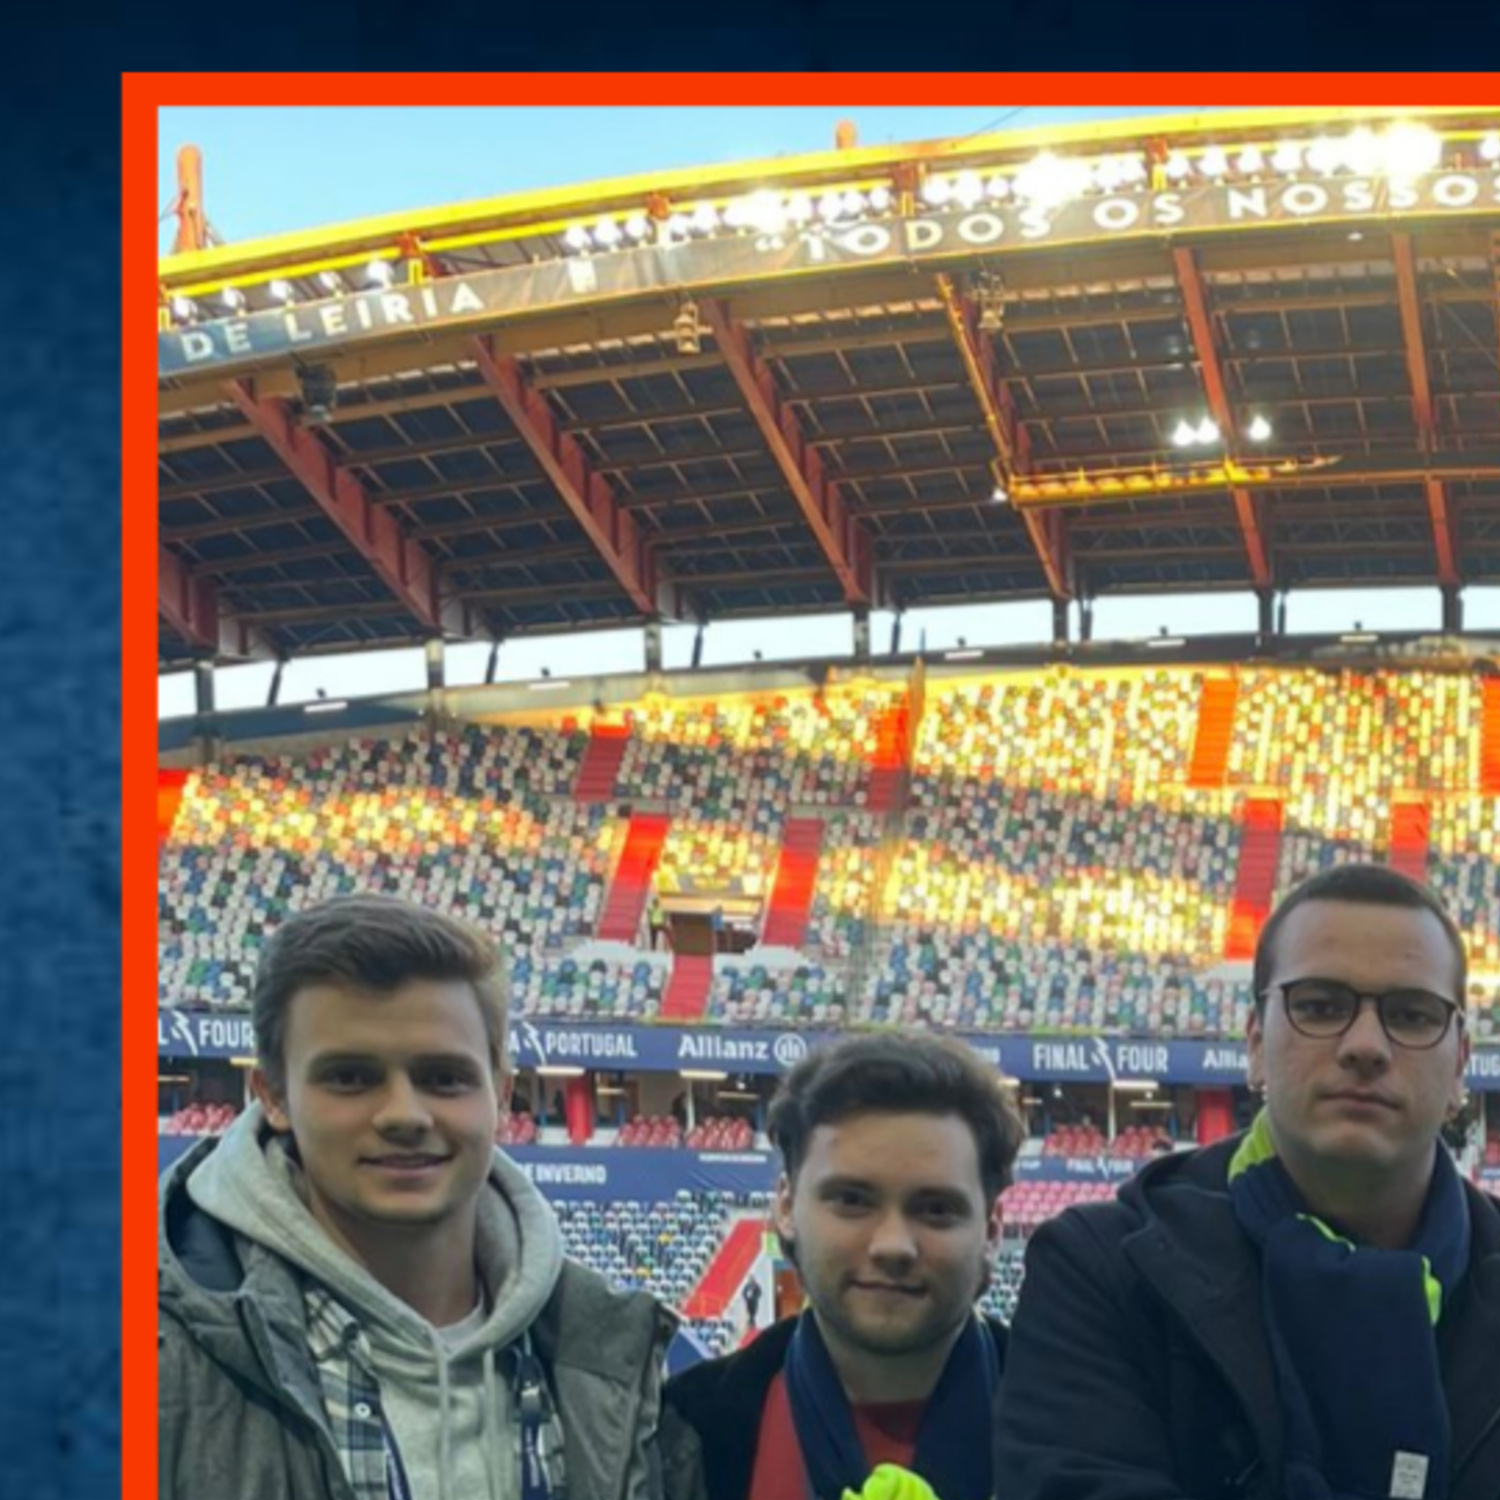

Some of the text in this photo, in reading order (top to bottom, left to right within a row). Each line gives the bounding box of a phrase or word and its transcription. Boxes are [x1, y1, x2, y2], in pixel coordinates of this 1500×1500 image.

[1093, 192, 1184, 229] OS
[180, 282, 485, 362] DE LEIRIA
[546, 1031, 638, 1058] PORTUGAL
[678, 1034, 769, 1060] Allianz
[1033, 1043, 1168, 1073] FINAL FOUR
